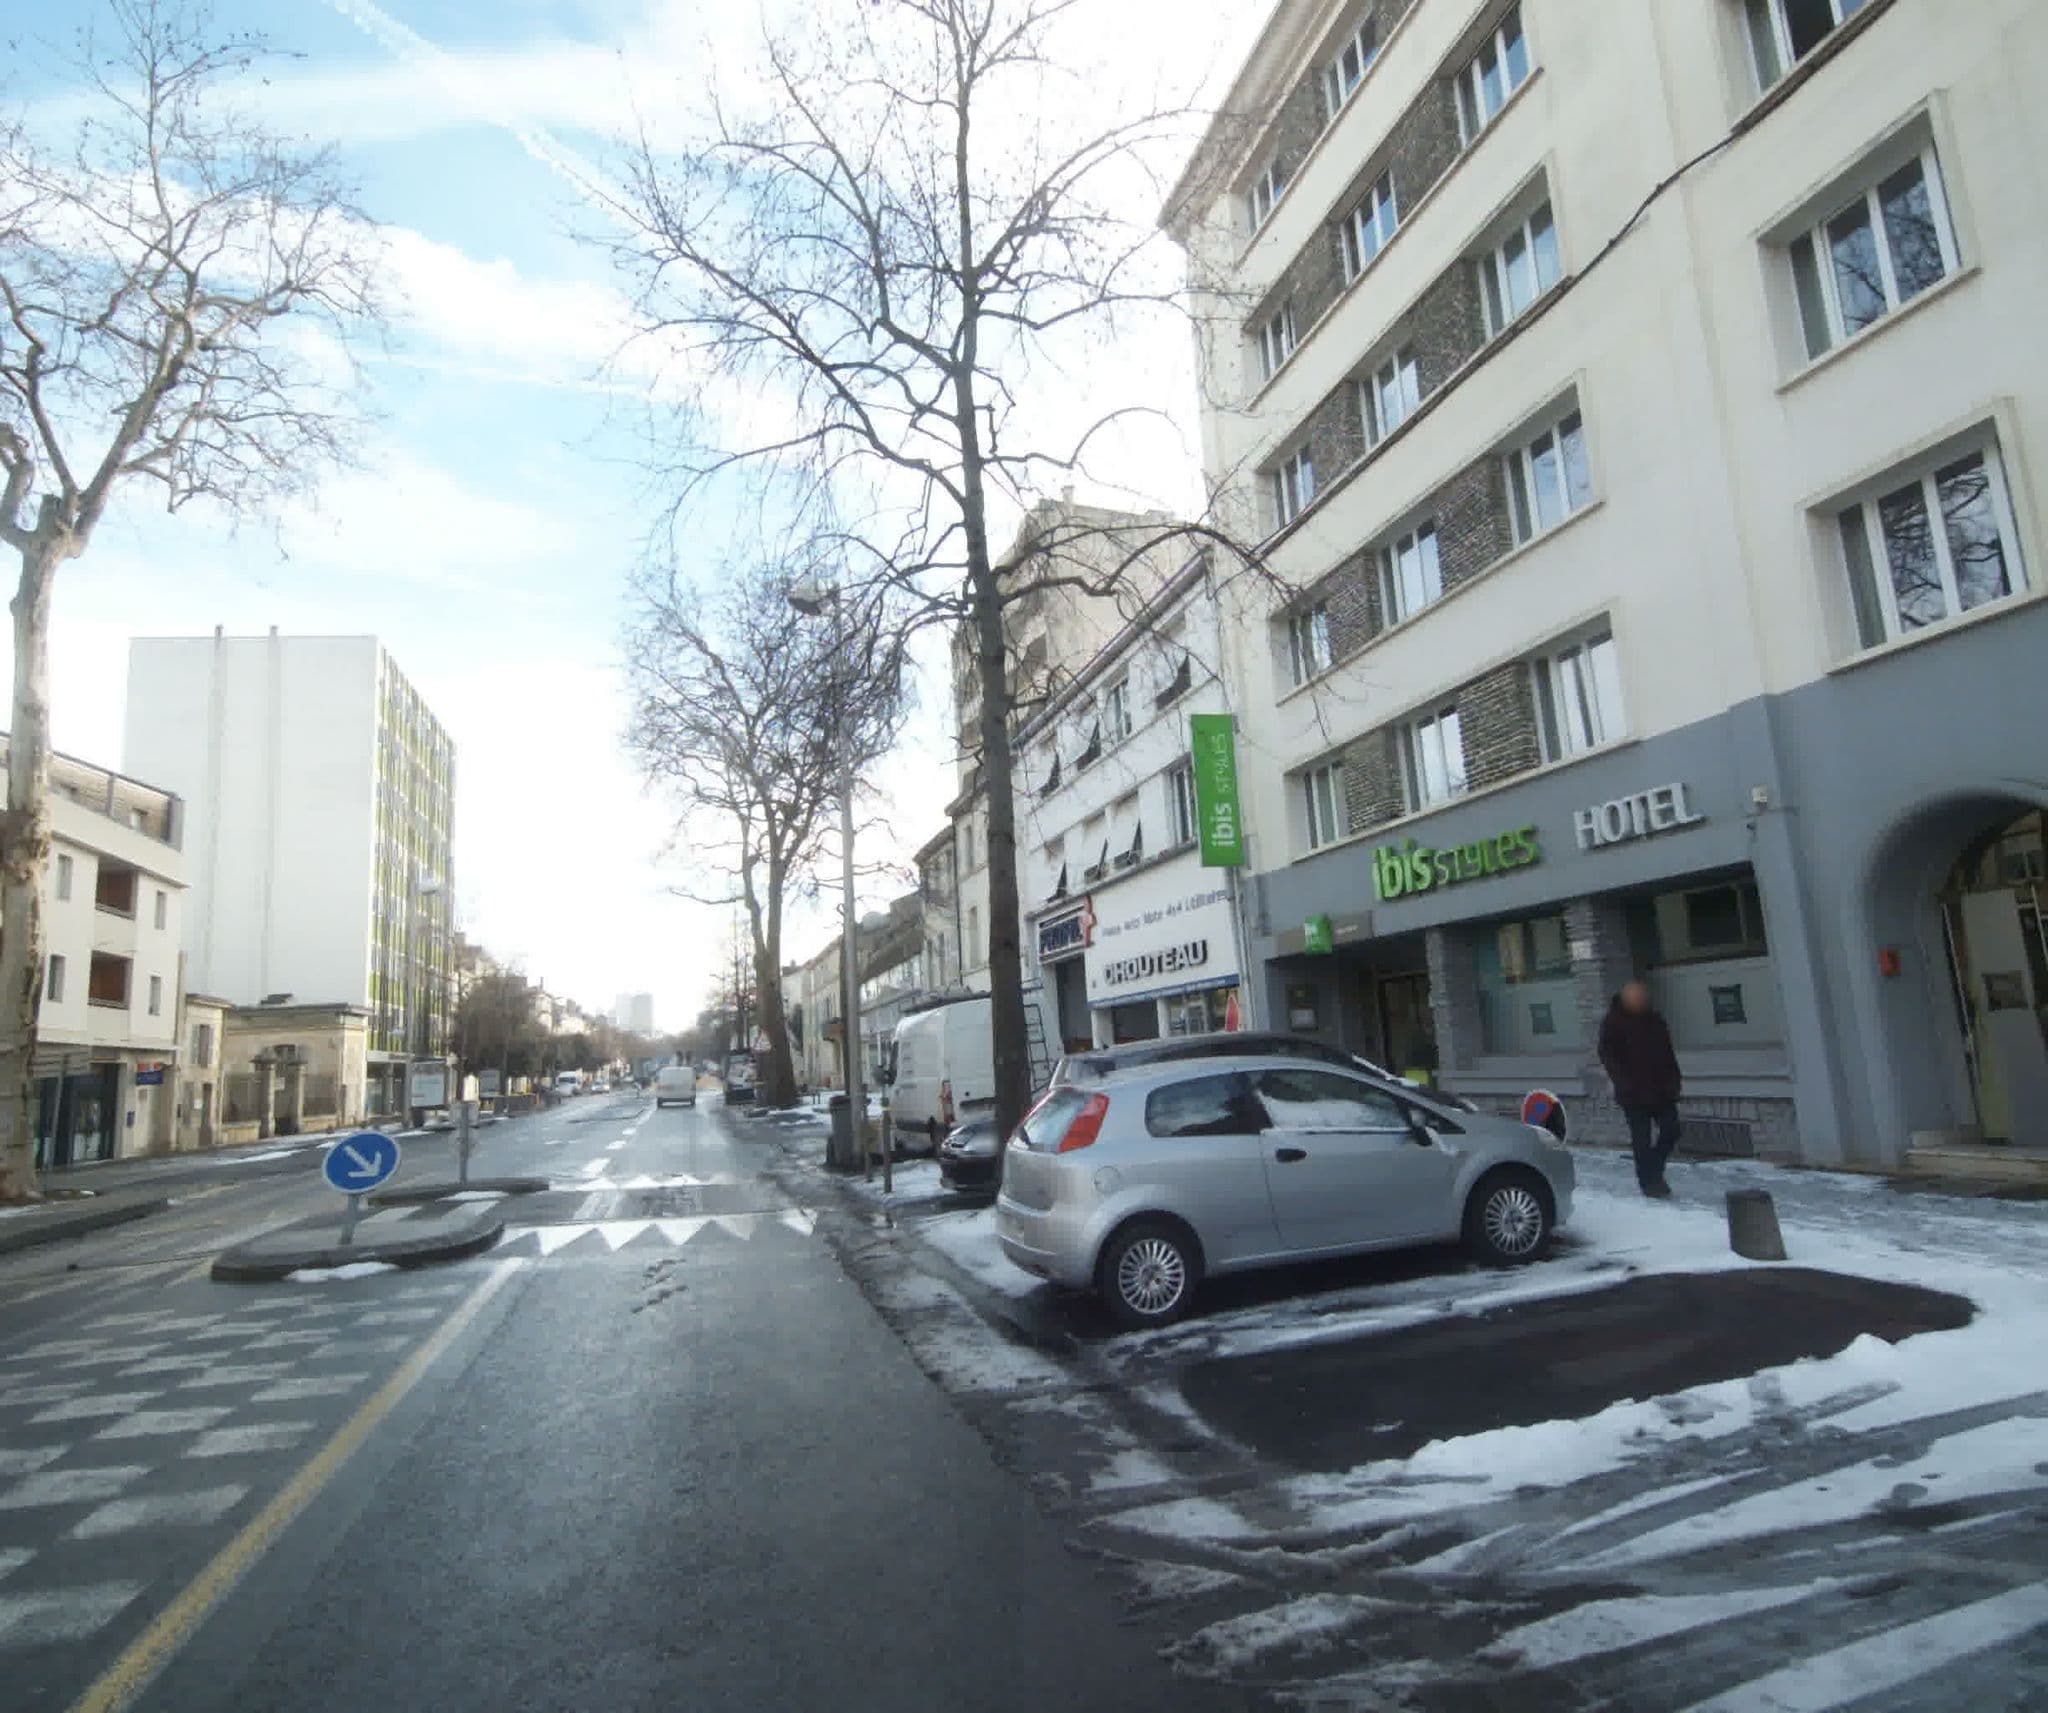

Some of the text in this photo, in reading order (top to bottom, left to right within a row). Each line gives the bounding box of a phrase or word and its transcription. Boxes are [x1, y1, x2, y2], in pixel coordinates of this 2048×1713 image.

[1211, 802, 1235, 847] ibis
[1573, 782, 1704, 849] HOTEL
[1372, 839, 1434, 901] ibis
